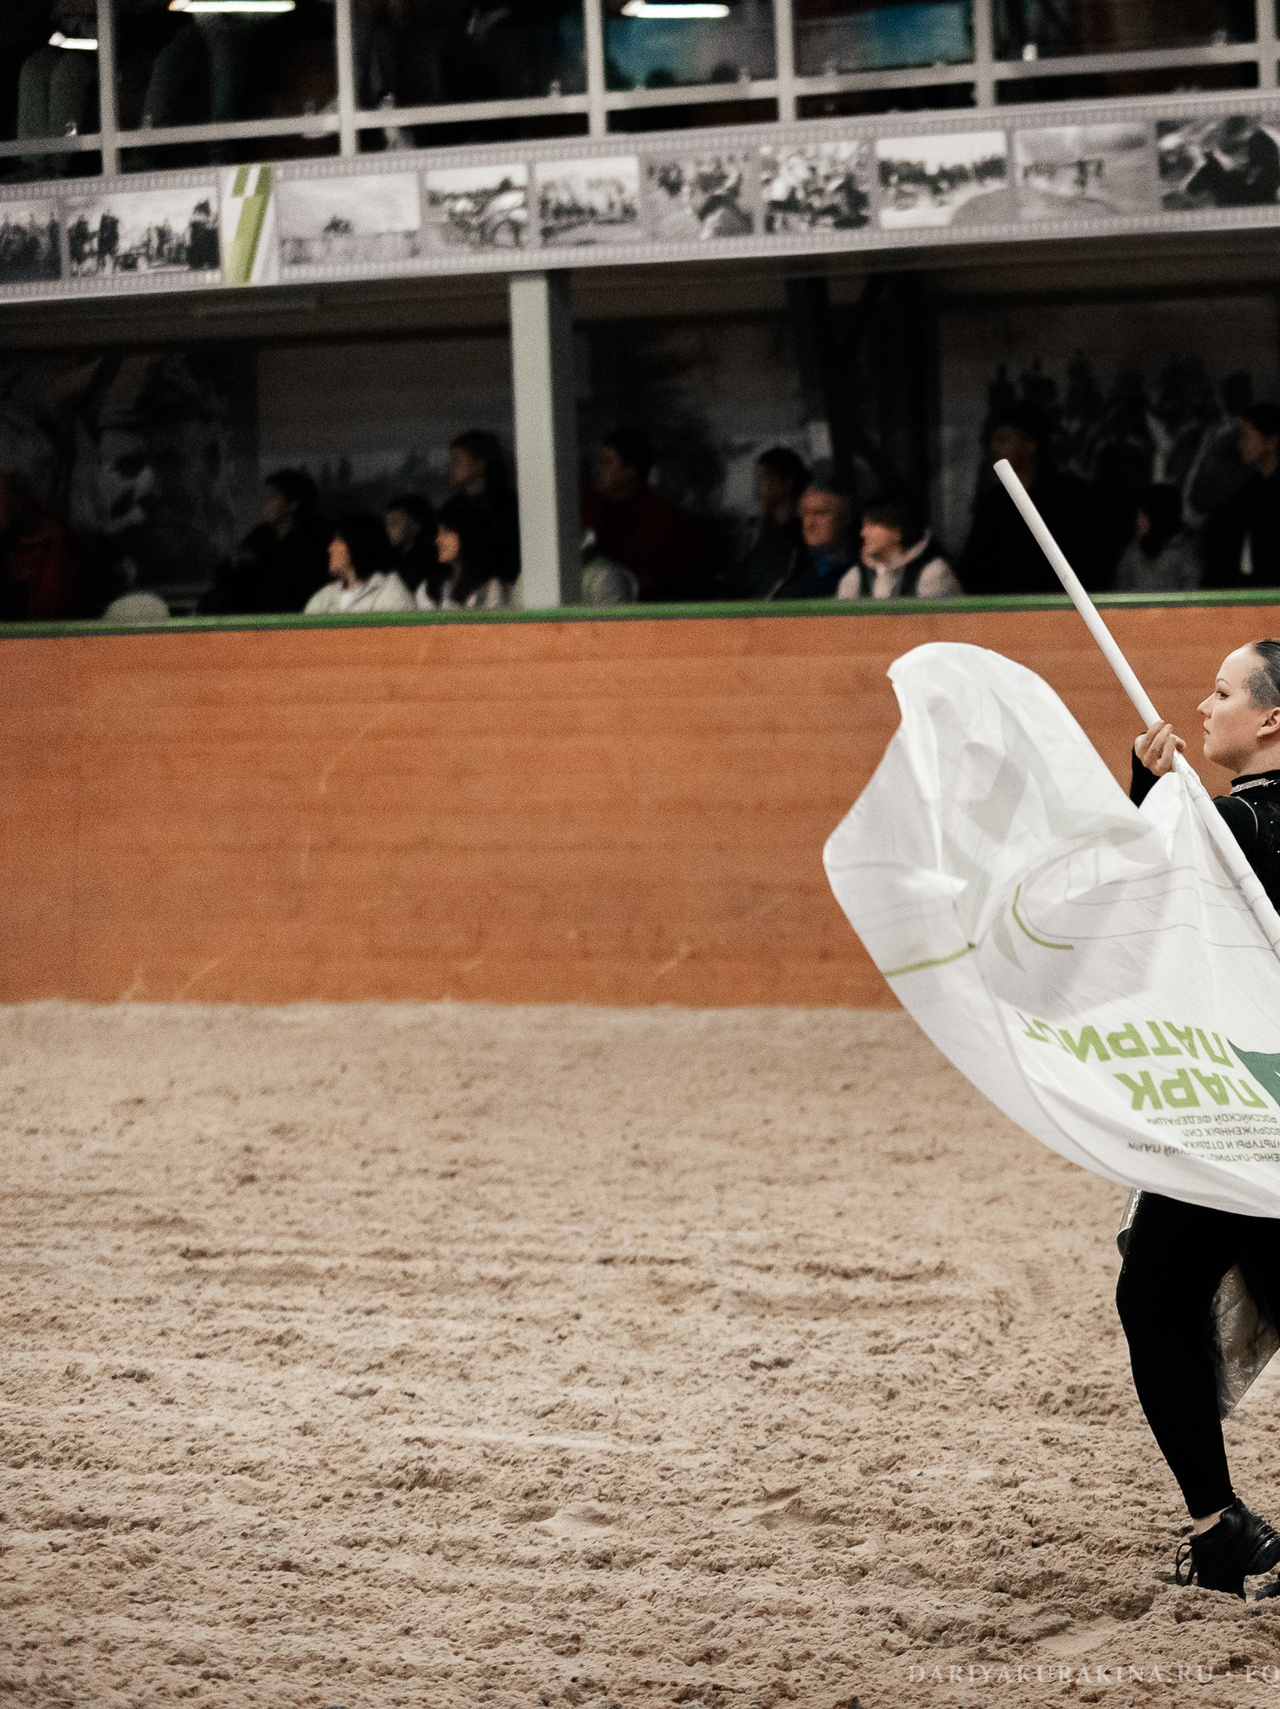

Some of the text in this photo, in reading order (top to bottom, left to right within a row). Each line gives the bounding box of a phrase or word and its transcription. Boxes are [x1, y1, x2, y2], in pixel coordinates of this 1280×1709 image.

[1112, 1067, 1269, 1111] ПАРК
[1214, 1113, 1278, 1125] РОССИЙСКОЙ
[1182, 1128, 1203, 1137] СИЛ
[1226, 1141, 1234, 1150] И
